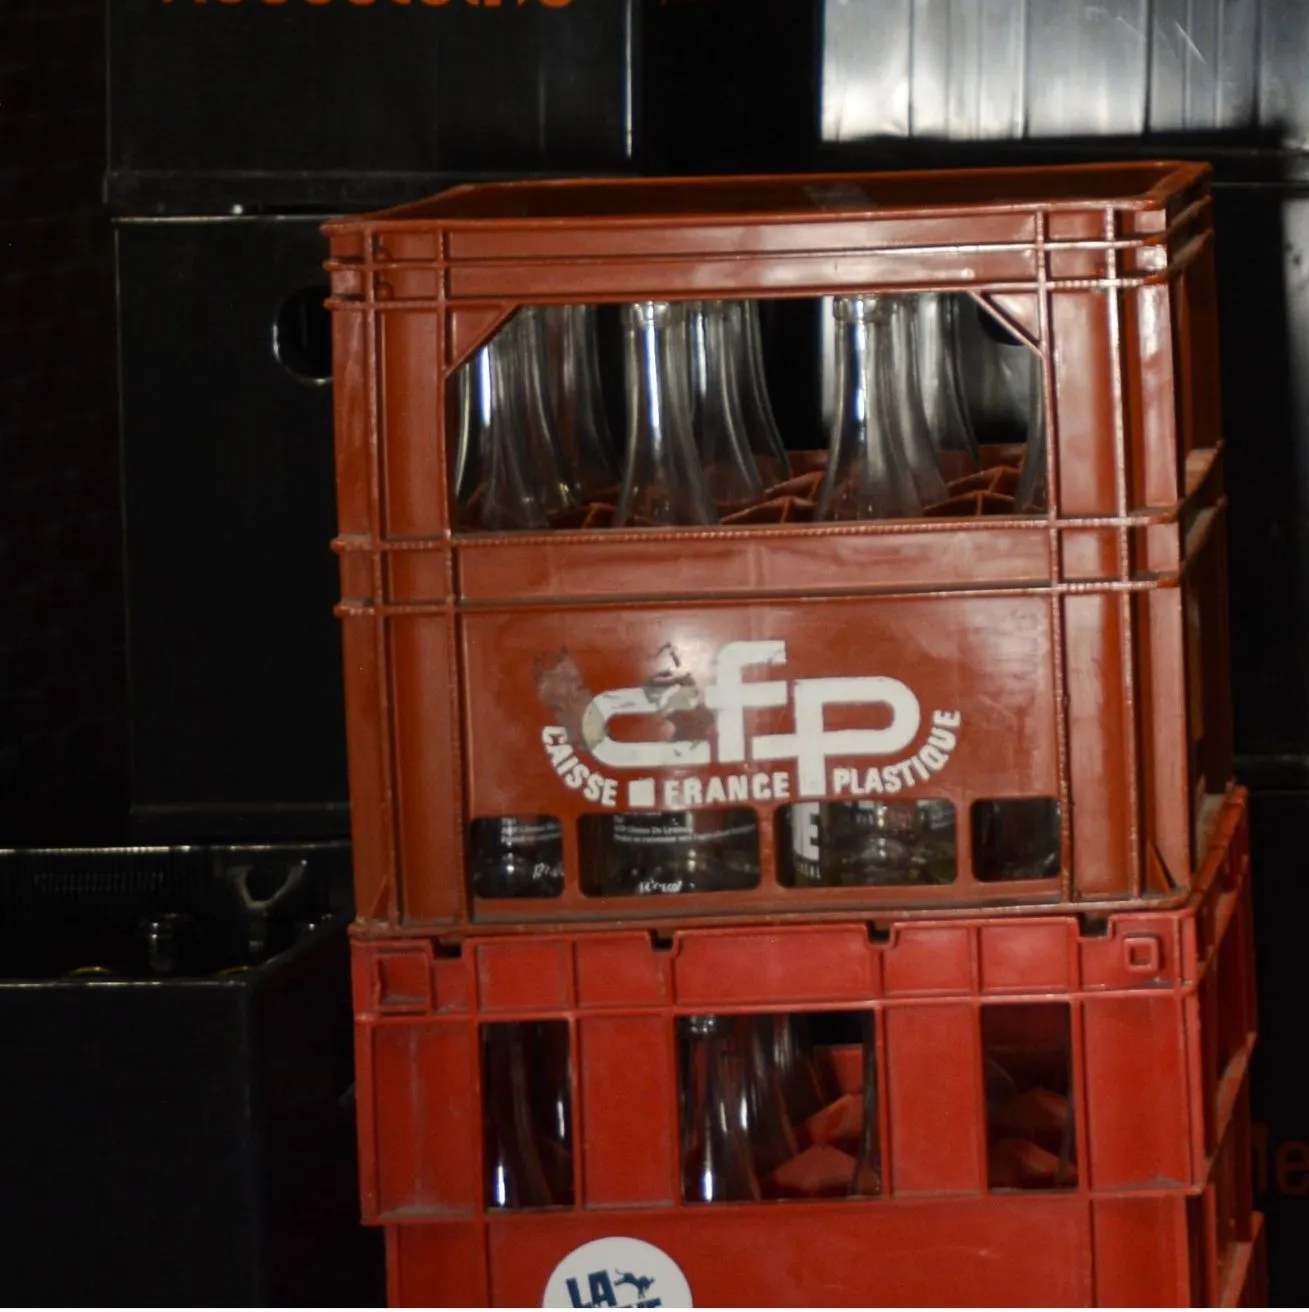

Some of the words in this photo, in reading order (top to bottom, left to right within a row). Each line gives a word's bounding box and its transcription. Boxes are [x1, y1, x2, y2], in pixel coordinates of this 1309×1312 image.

[541, 724, 619, 807] CAISSE
[663, 770, 790, 807] FRANCE
[831, 708, 962, 796] PLASTIQUE
[565, 1269, 618, 1308] LA
